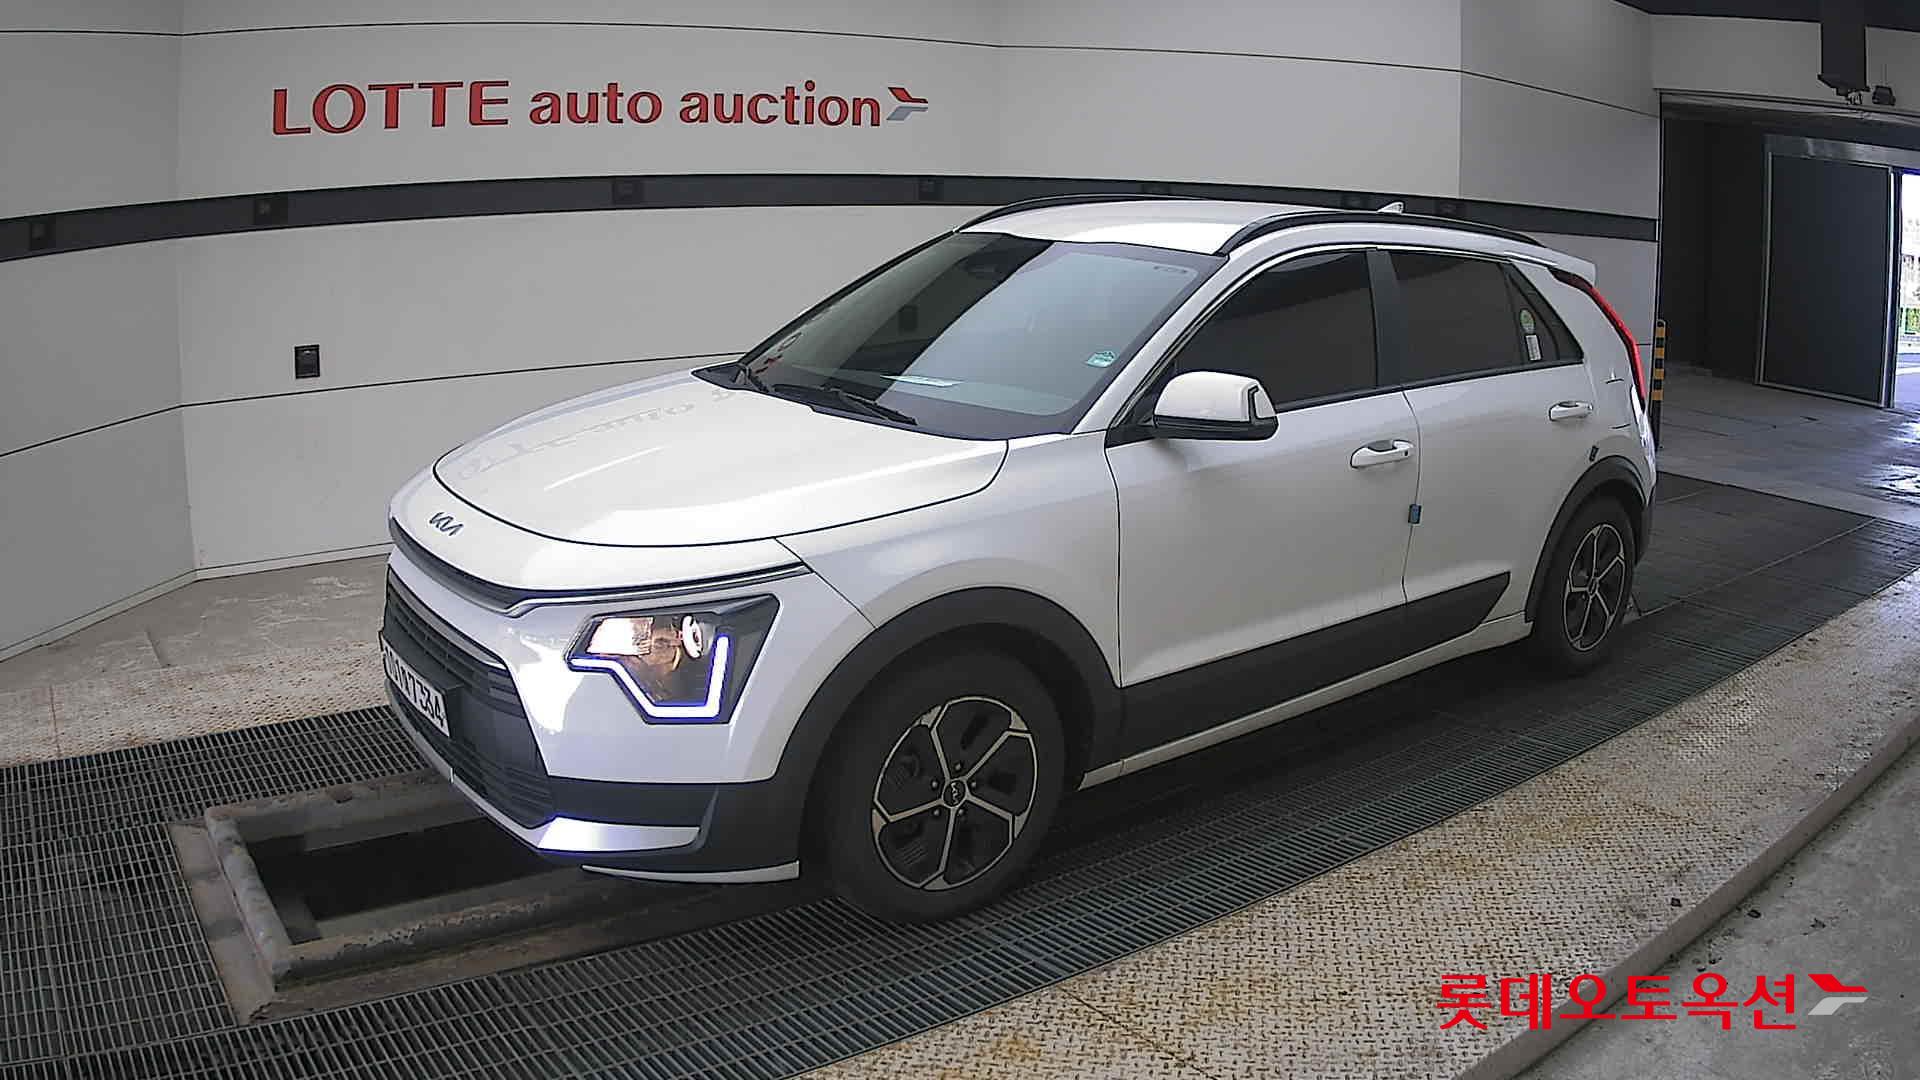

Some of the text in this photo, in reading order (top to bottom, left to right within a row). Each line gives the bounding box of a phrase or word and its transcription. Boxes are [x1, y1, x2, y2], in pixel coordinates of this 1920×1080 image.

[273, 80, 880, 135] LOTTE auto auction
